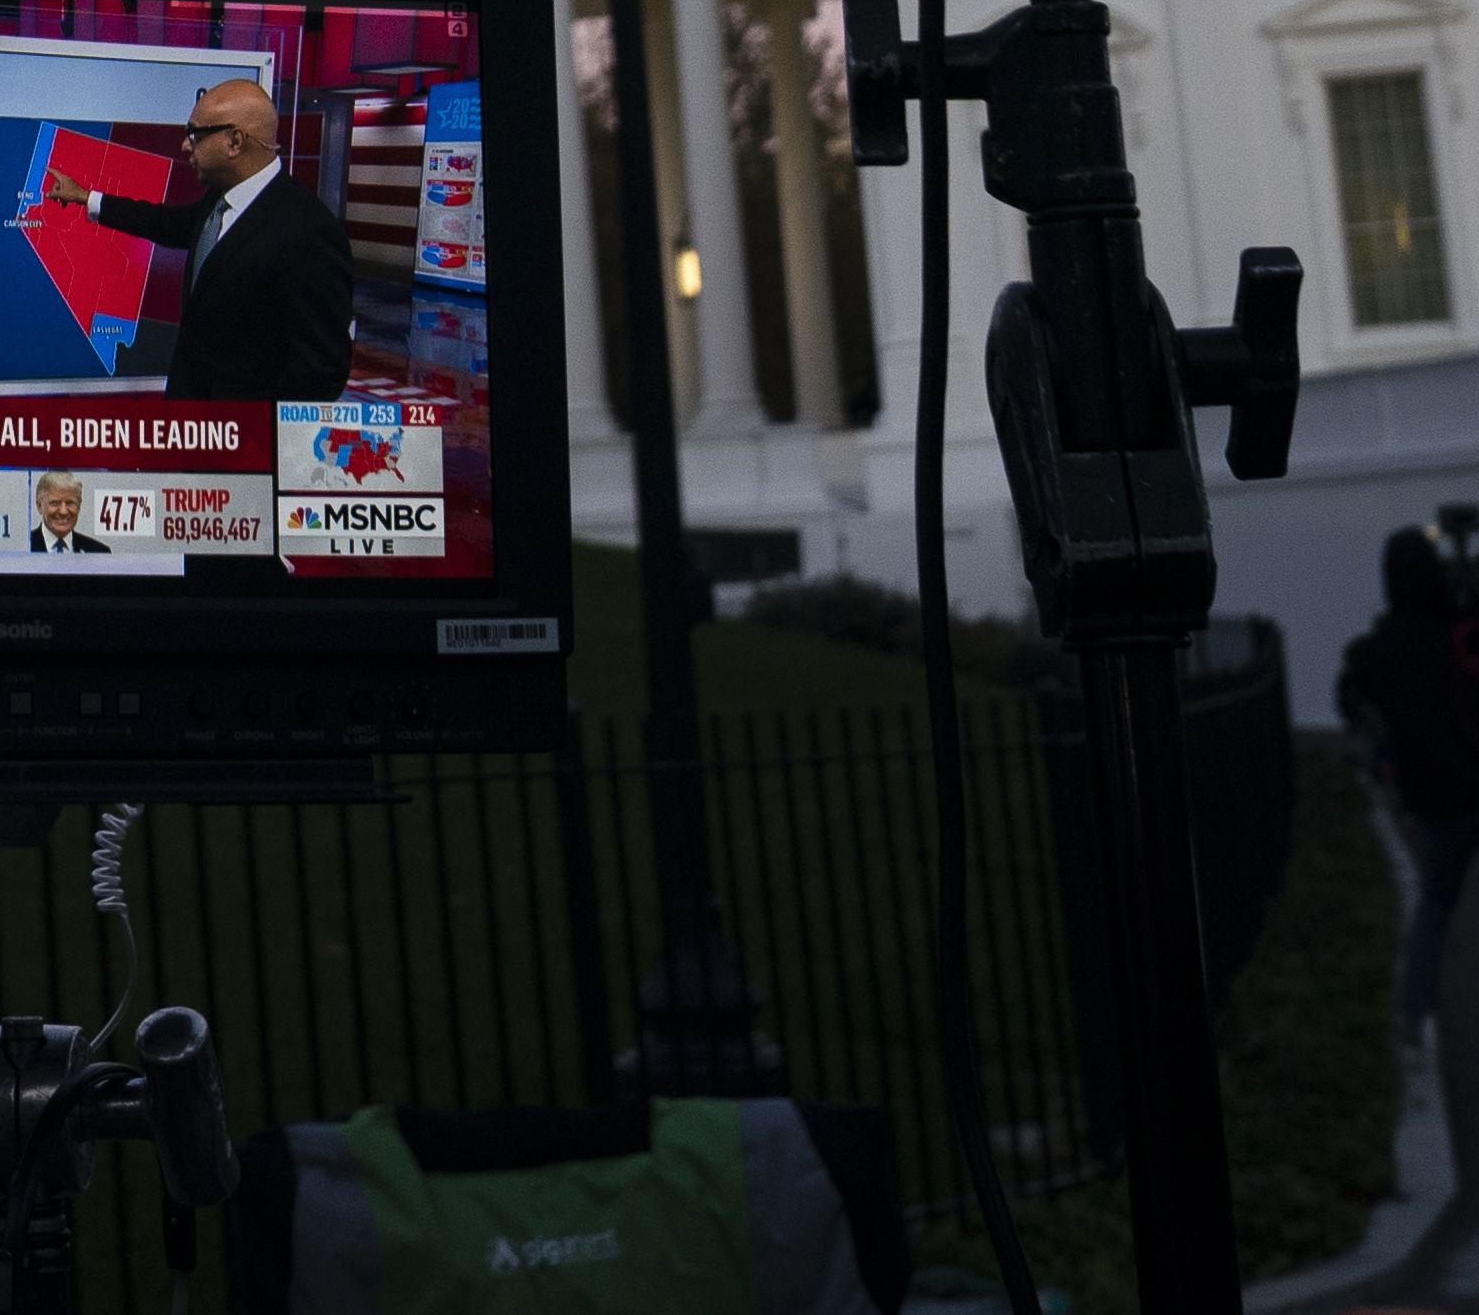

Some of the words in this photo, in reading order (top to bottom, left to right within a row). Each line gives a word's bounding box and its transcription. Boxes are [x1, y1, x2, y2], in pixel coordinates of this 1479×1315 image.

[279, 405, 320, 423] ROAD
[320, 407, 333, 421] TO
[333, 406, 359, 423] 270
[369, 405, 395, 424] 253
[408, 405, 437, 425] 214
[60, 418, 131, 449] BIDEN
[139, 419, 240, 451] LEADING
[161, 488, 231, 513] TRUMP
[99, 495, 152, 532] 47.7%
[324, 503, 437, 531] MSNBC
[162, 516, 262, 544] 69,946,467
[330, 538, 395, 555] LIVE
[33, 726, 77, 737] FUNCTION
[395, 729, 434, 741] VOLUME
